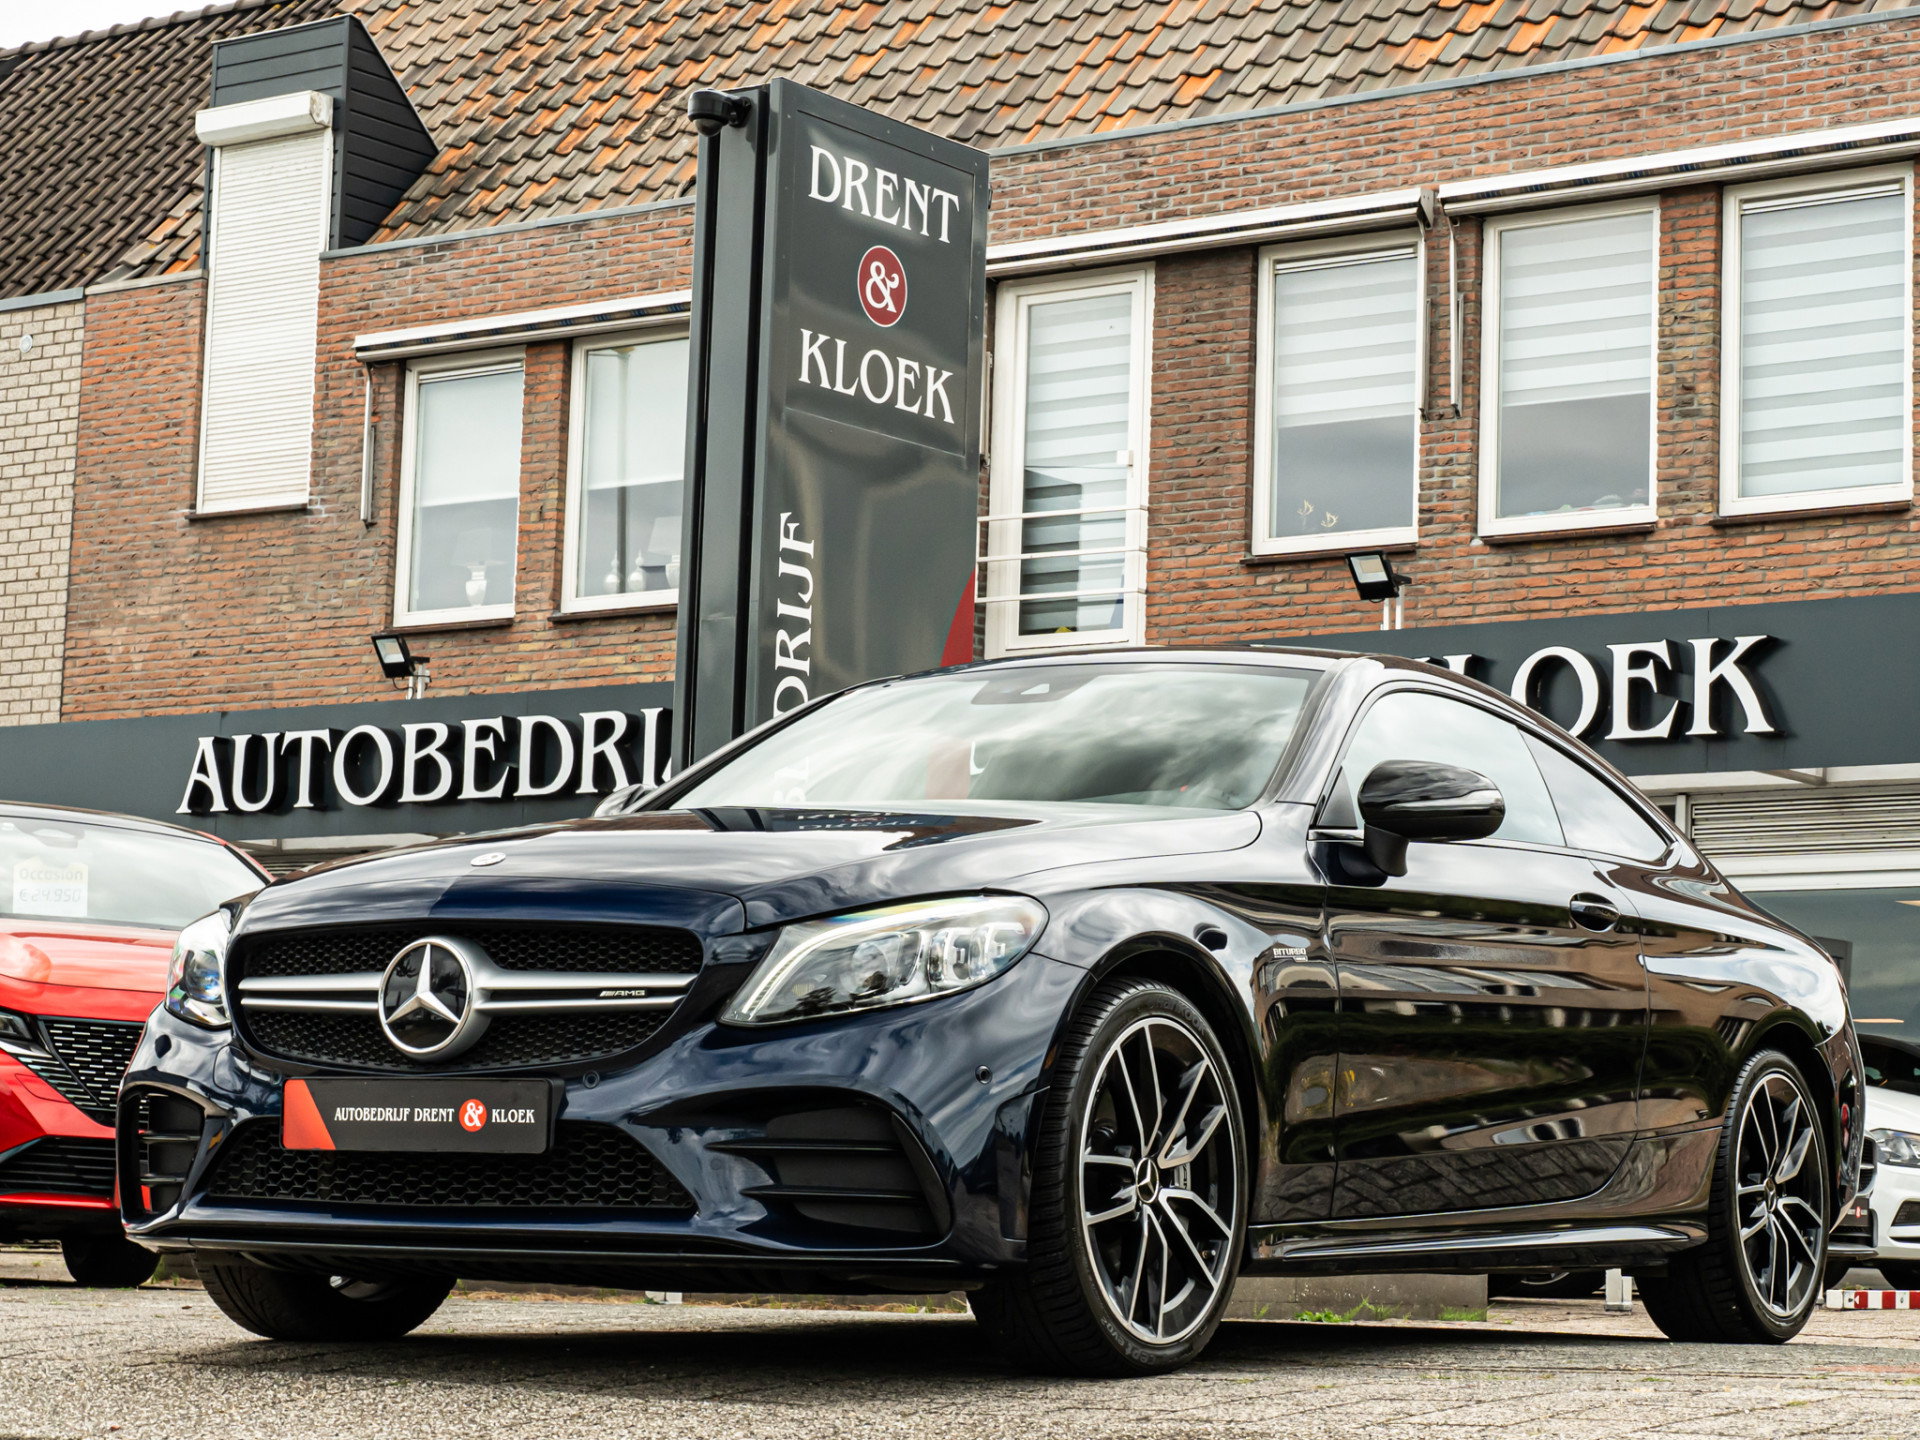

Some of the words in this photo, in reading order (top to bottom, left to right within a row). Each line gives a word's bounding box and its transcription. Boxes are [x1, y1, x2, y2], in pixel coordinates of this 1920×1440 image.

[808, 145, 960, 244] DRENT
[865, 260, 899, 313] &
[798, 328, 954, 424] KLOEK
[1414, 635, 1775, 740] OEK
[176, 707, 672, 814] AUTOBEDRI
[19, 868, 83, 880] Occasion
[1273, 947, 1307, 956] BITURBO
[334, 1107, 411, 1122] AUTOBEDRIJF
[414, 1108, 455, 1122] DRENT
[464, 1102, 484, 1127] &
[491, 1109, 535, 1123] KLOEK
